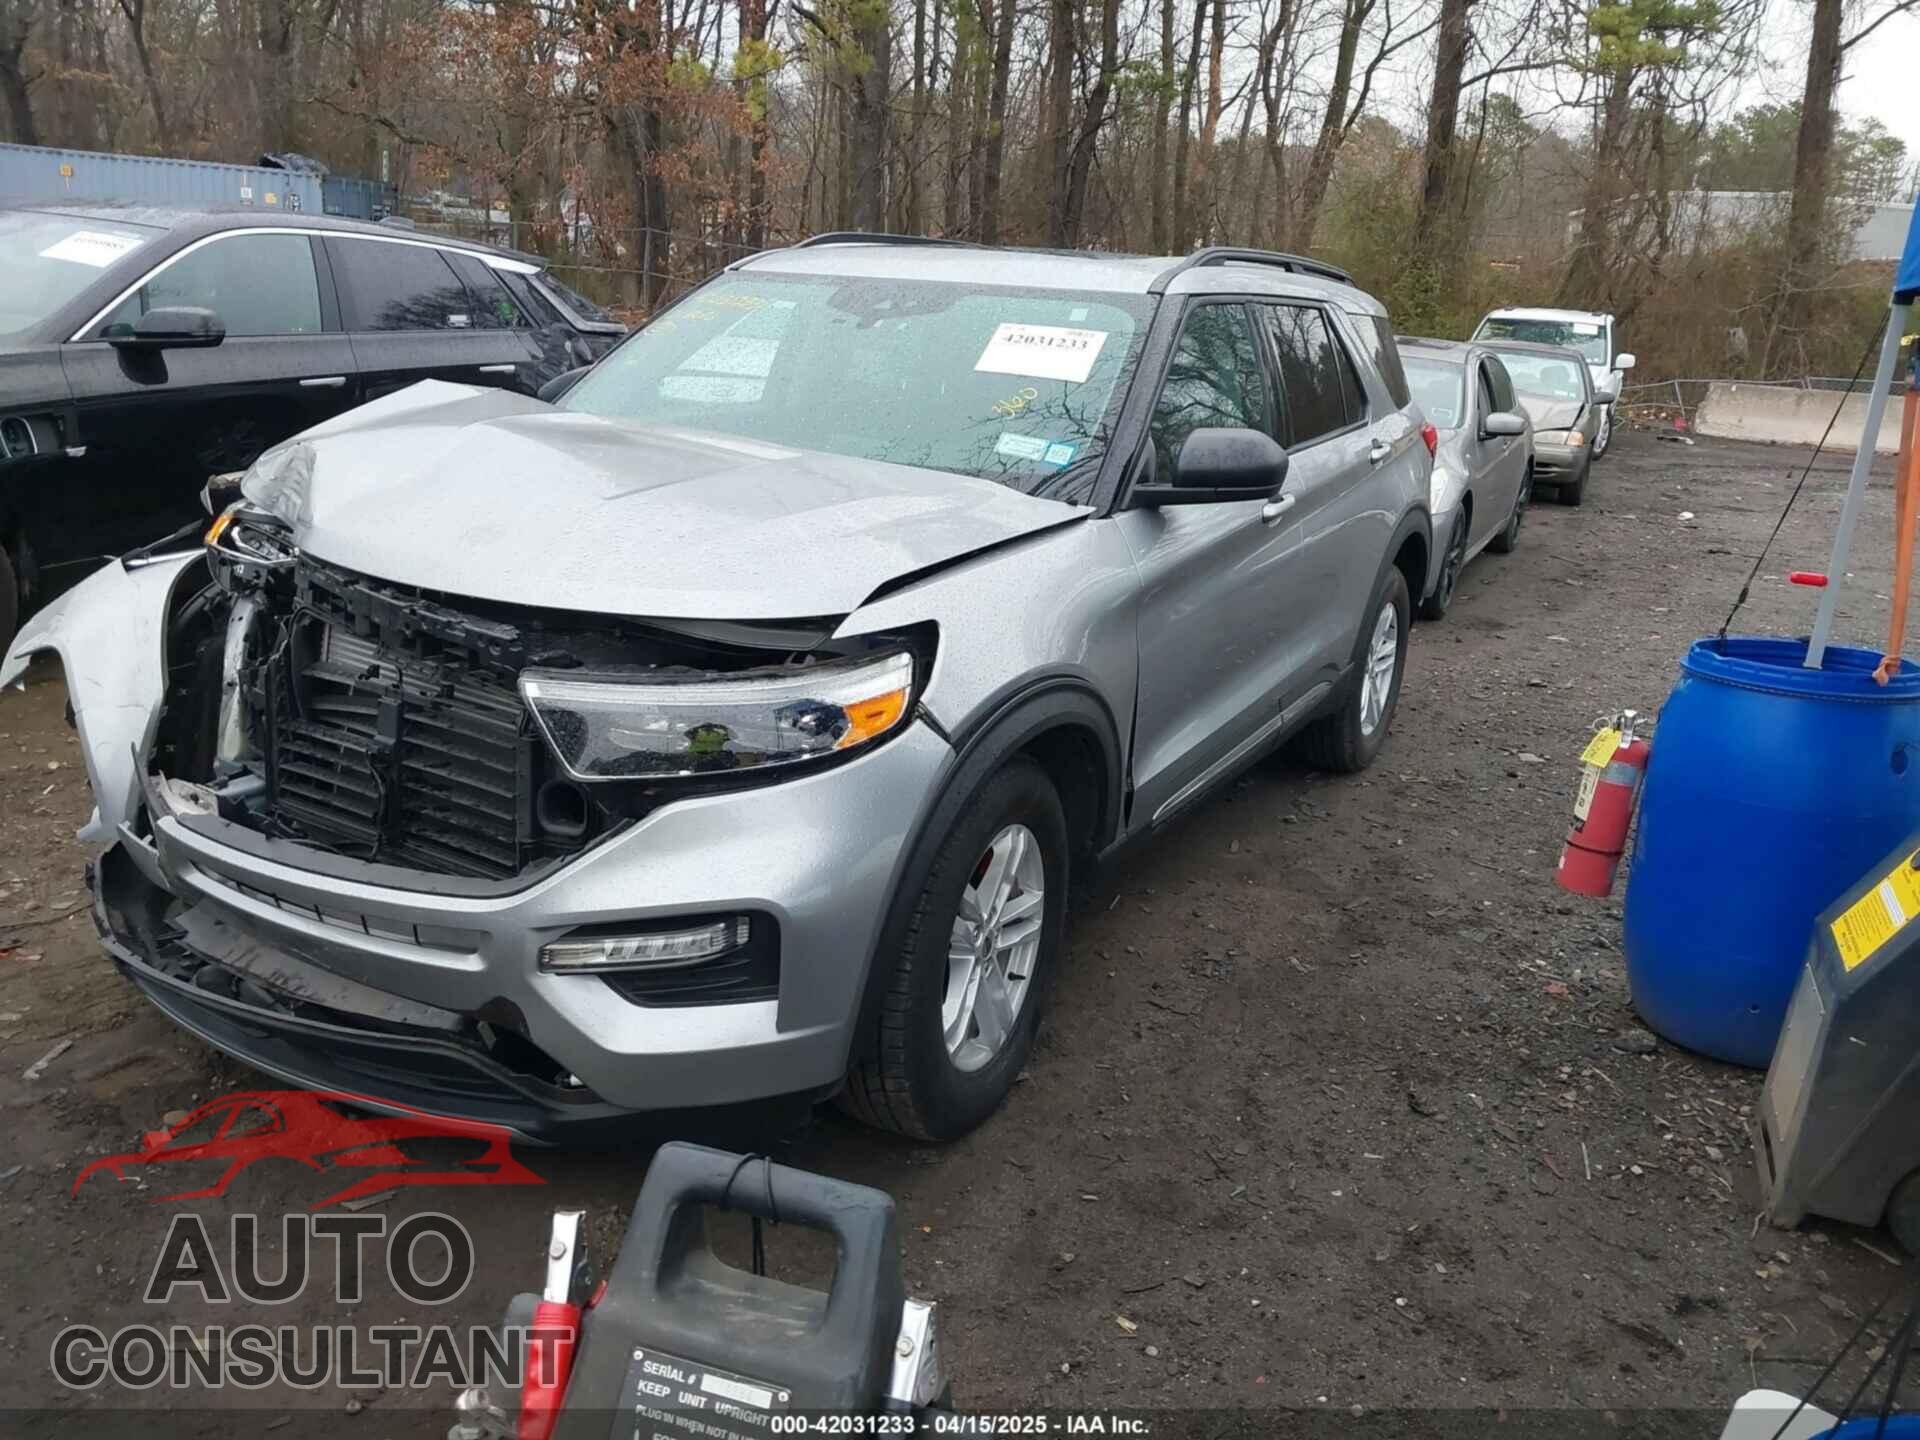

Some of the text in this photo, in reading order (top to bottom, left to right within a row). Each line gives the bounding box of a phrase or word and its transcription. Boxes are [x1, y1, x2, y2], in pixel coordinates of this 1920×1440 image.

[1003, 333, 1088, 349] 42031233
[643, 1360, 686, 1382] SERIAL
[637, 1379, 769, 1427] KEEP UNIT UPRIGHT
[635, 1404, 662, 1420] PLUG
[705, 1425, 729, 1439] NOT
